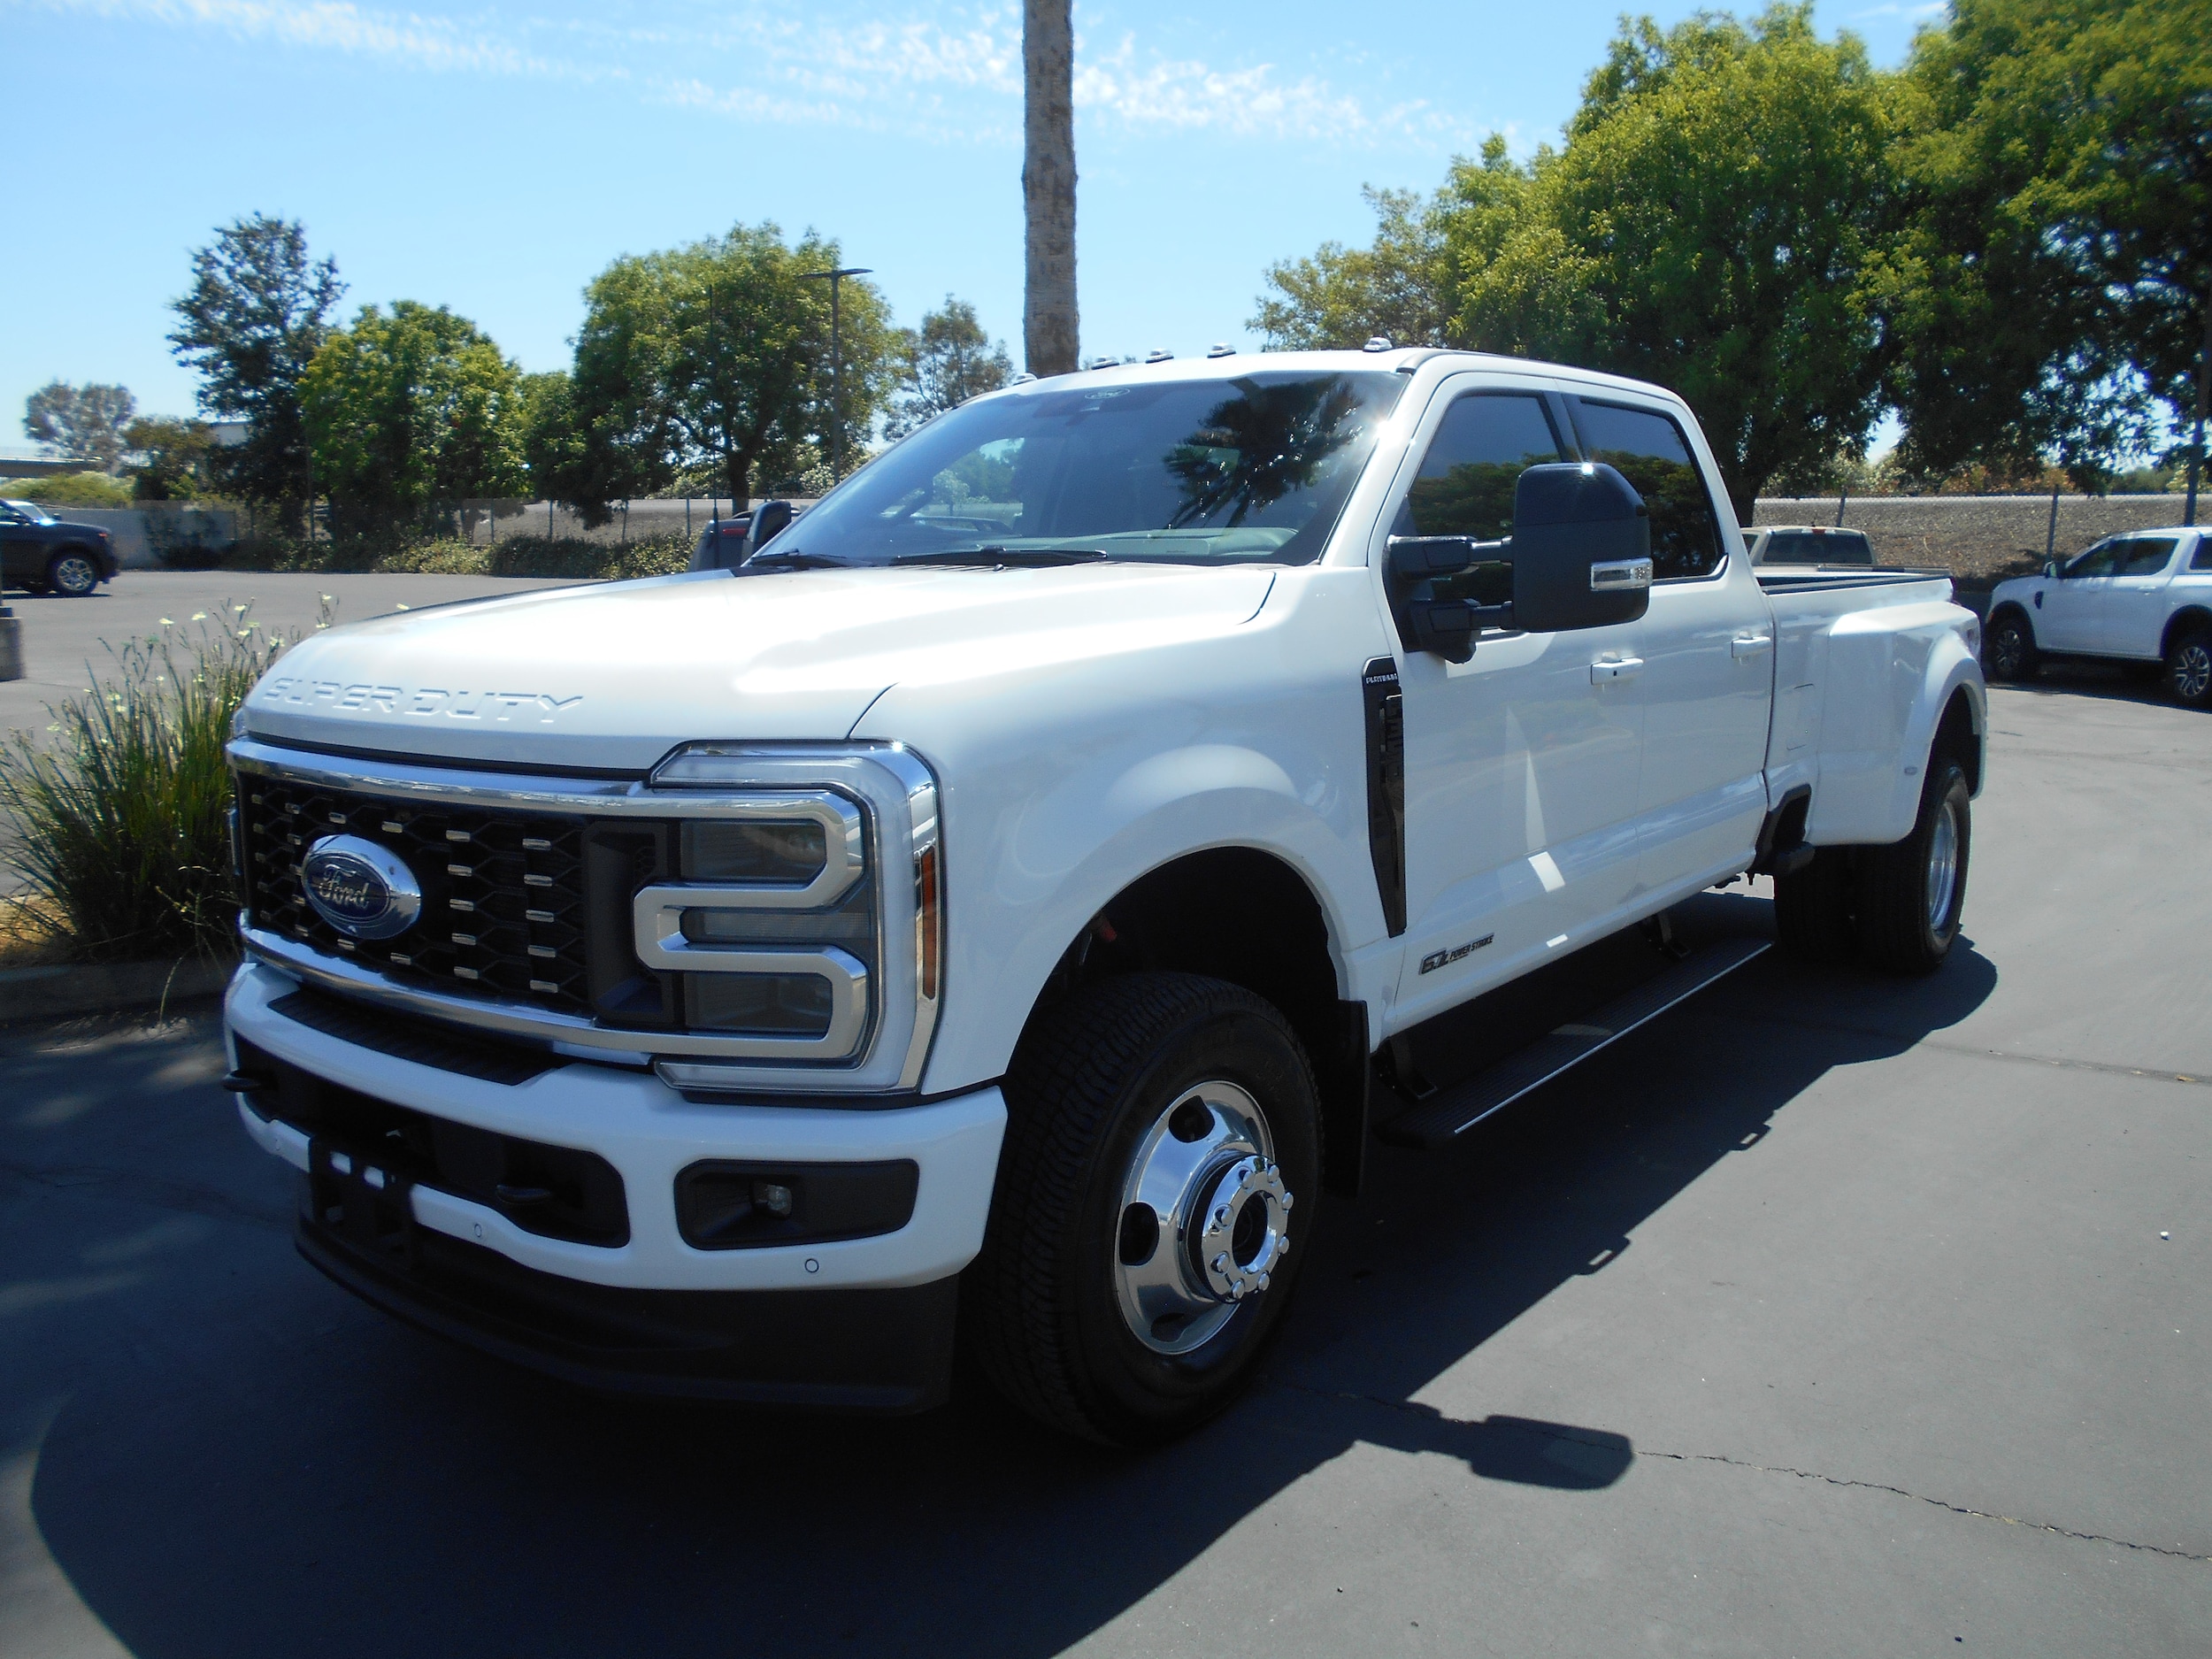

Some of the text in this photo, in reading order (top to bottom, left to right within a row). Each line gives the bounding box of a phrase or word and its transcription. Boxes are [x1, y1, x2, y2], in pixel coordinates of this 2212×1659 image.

[263, 678, 584, 723] SUPER DUTY
[319, 863, 369, 909] Ford
